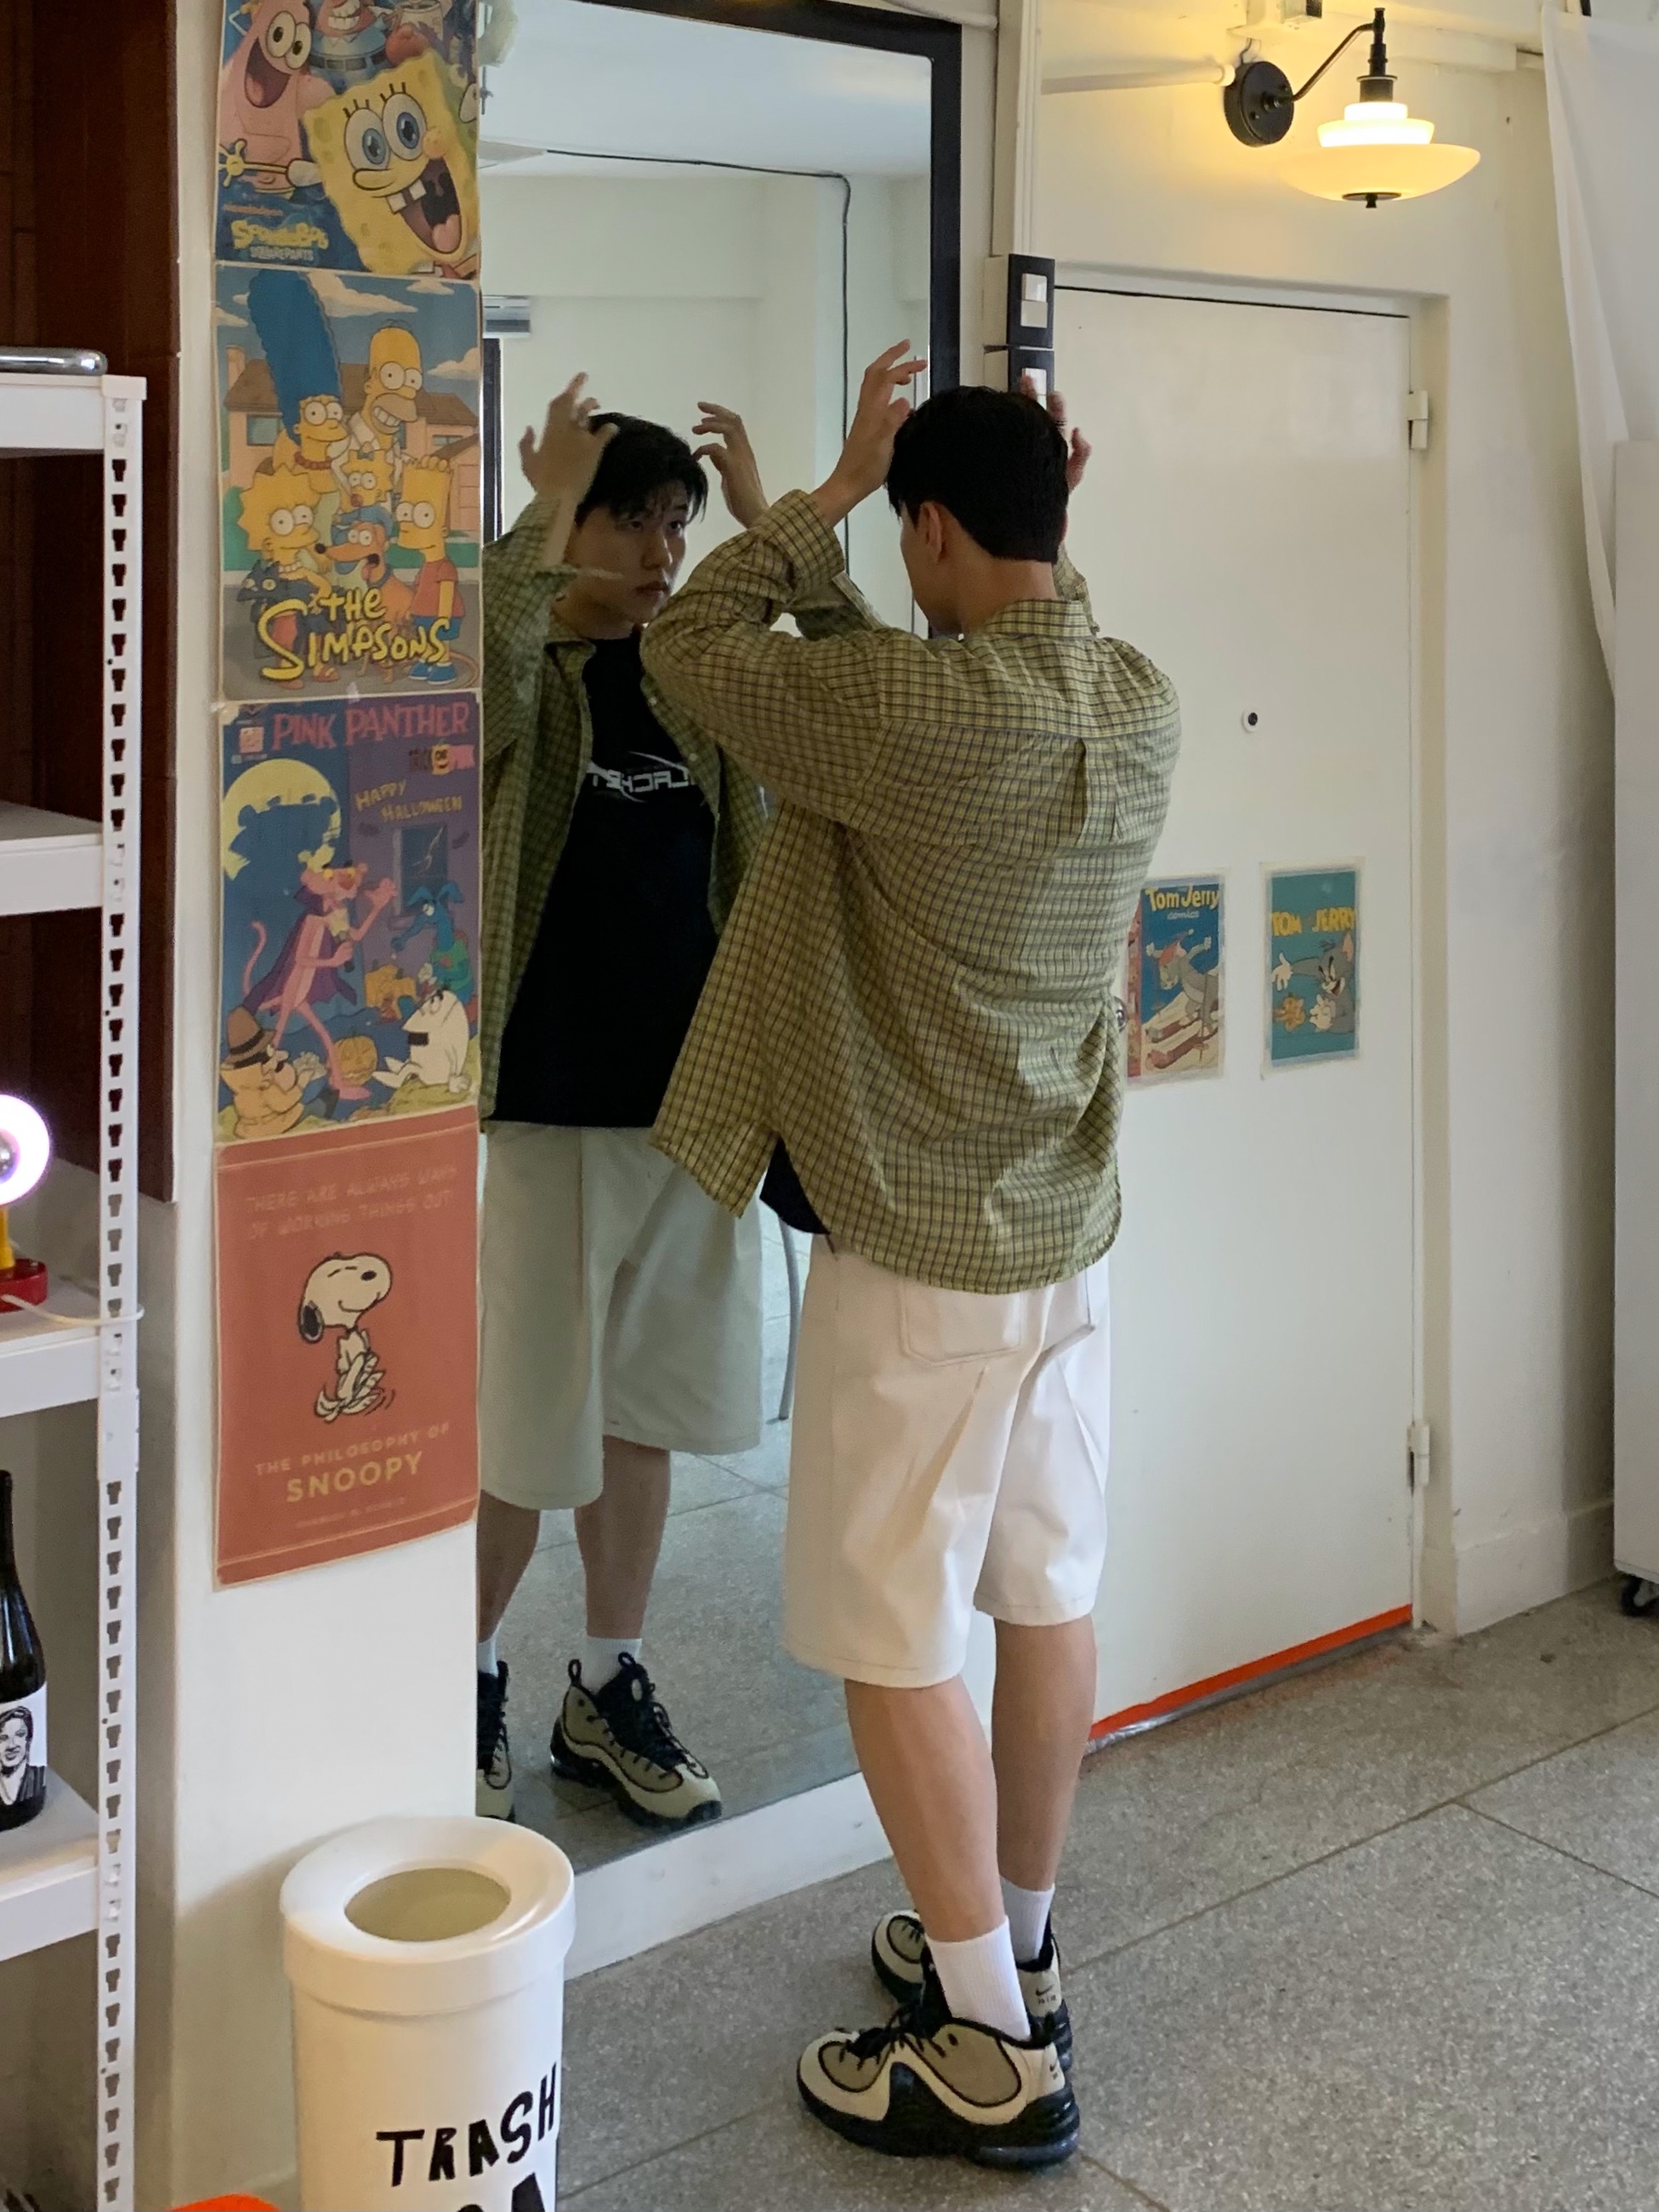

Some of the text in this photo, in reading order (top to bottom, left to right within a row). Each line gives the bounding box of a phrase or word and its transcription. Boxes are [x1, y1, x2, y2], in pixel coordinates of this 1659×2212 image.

[272, 702, 470, 750] PINK PANTHER
[355, 778, 406, 812] HAPPY
[1145, 884, 1220, 913] Tom Jerry
[1271, 907, 1355, 936] TOM JERRY
[306, 1183, 338, 1204] ARE
[423, 1189, 452, 1209] OUT
[255, 1421, 450, 1476] THE PHILOSOPHY OF
[286, 1450, 423, 1503] SNOOPY
[375, 2061, 557, 2188] TRASH
